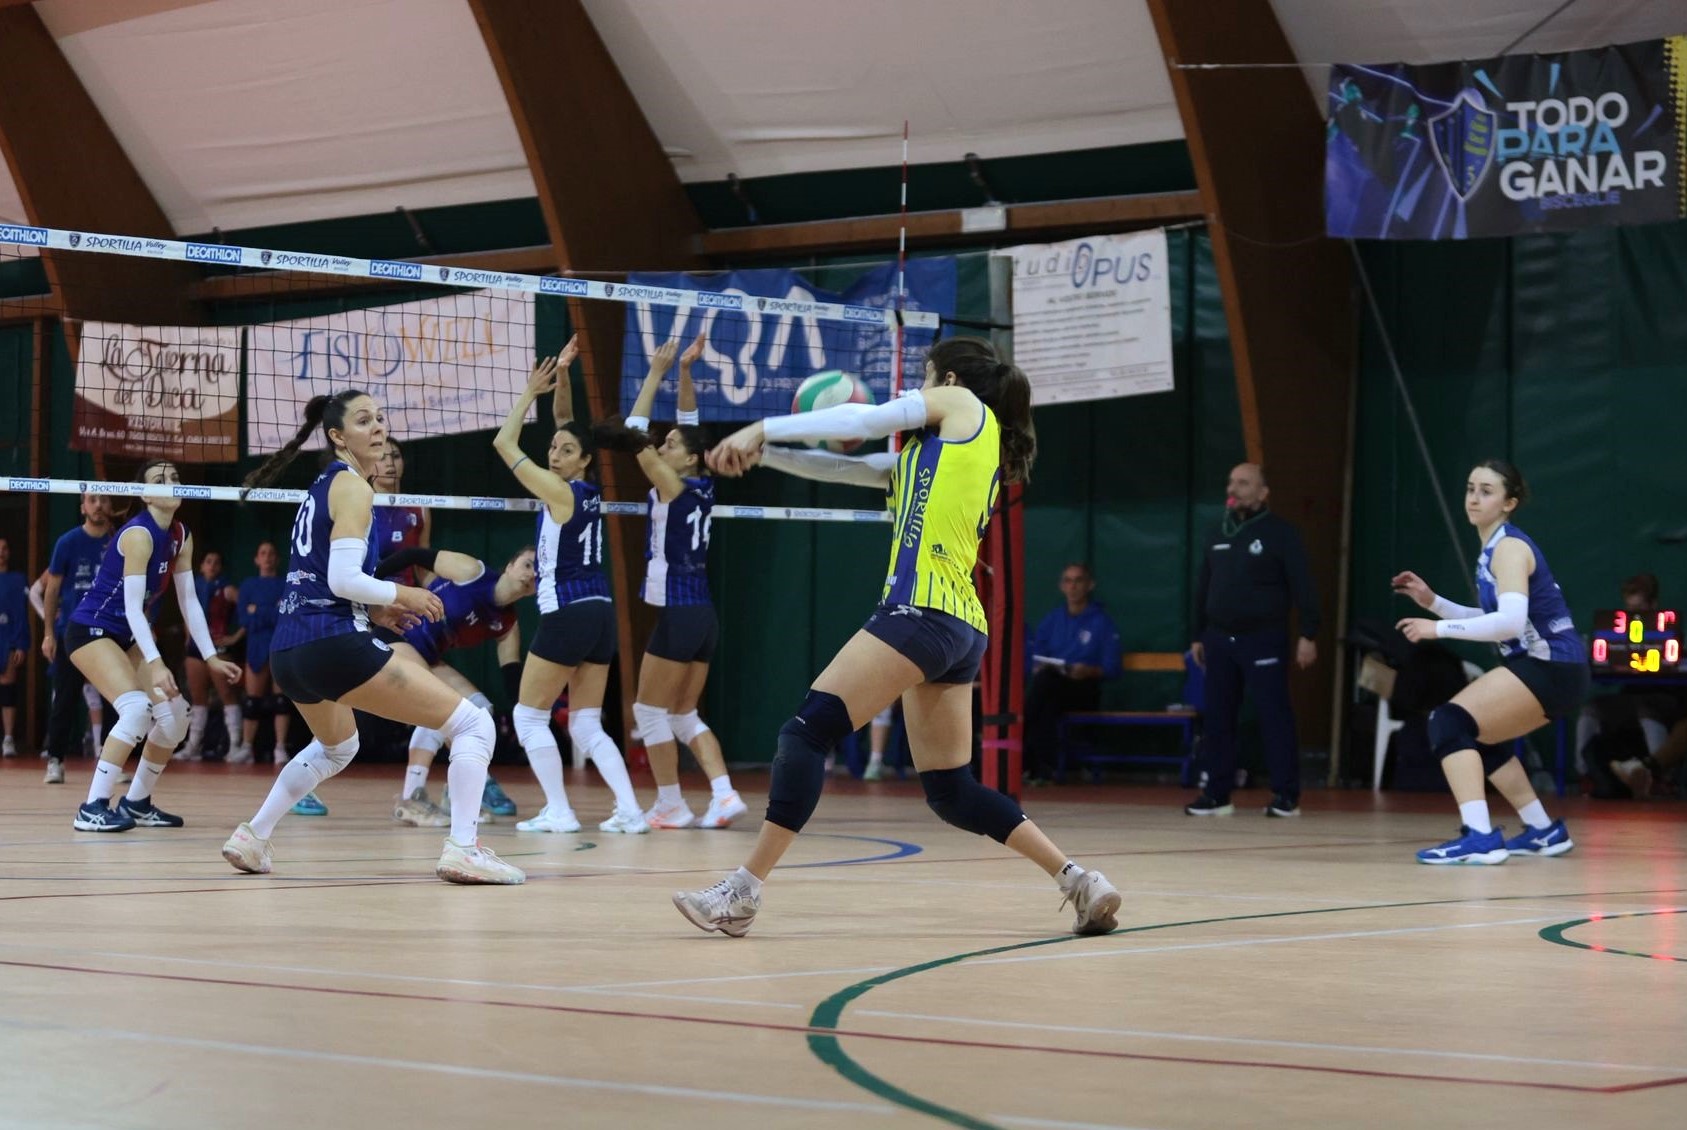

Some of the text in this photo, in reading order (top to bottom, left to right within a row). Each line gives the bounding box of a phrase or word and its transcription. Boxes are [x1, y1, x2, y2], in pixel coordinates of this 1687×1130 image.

[1506, 92, 1629, 134] TODO
[1496, 121, 1621, 162] PARA
[1500, 150, 1667, 201] GANAR
[86, 236, 142, 251] SPORTILIA
[187, 245, 240, 262] DECATHLON
[276, 254, 329, 268] SPORTILIA
[371, 262, 421, 279] DECATHLON
[454, 271, 502, 284] SPORTILIA
[541, 278, 587, 294] DECATHLON
[618, 287, 664, 299] SPORTILIA
[698, 294, 742, 308] DECATHLON
[10, 481, 49, 491] DECATHLON
[90, 485, 129, 494] SPORTILIA
[174, 487, 211, 498] DECATHLON
[291, 494, 316, 557] 0
[1593, 639, 1607, 662] 0
[1664, 639, 1679, 662] 0
